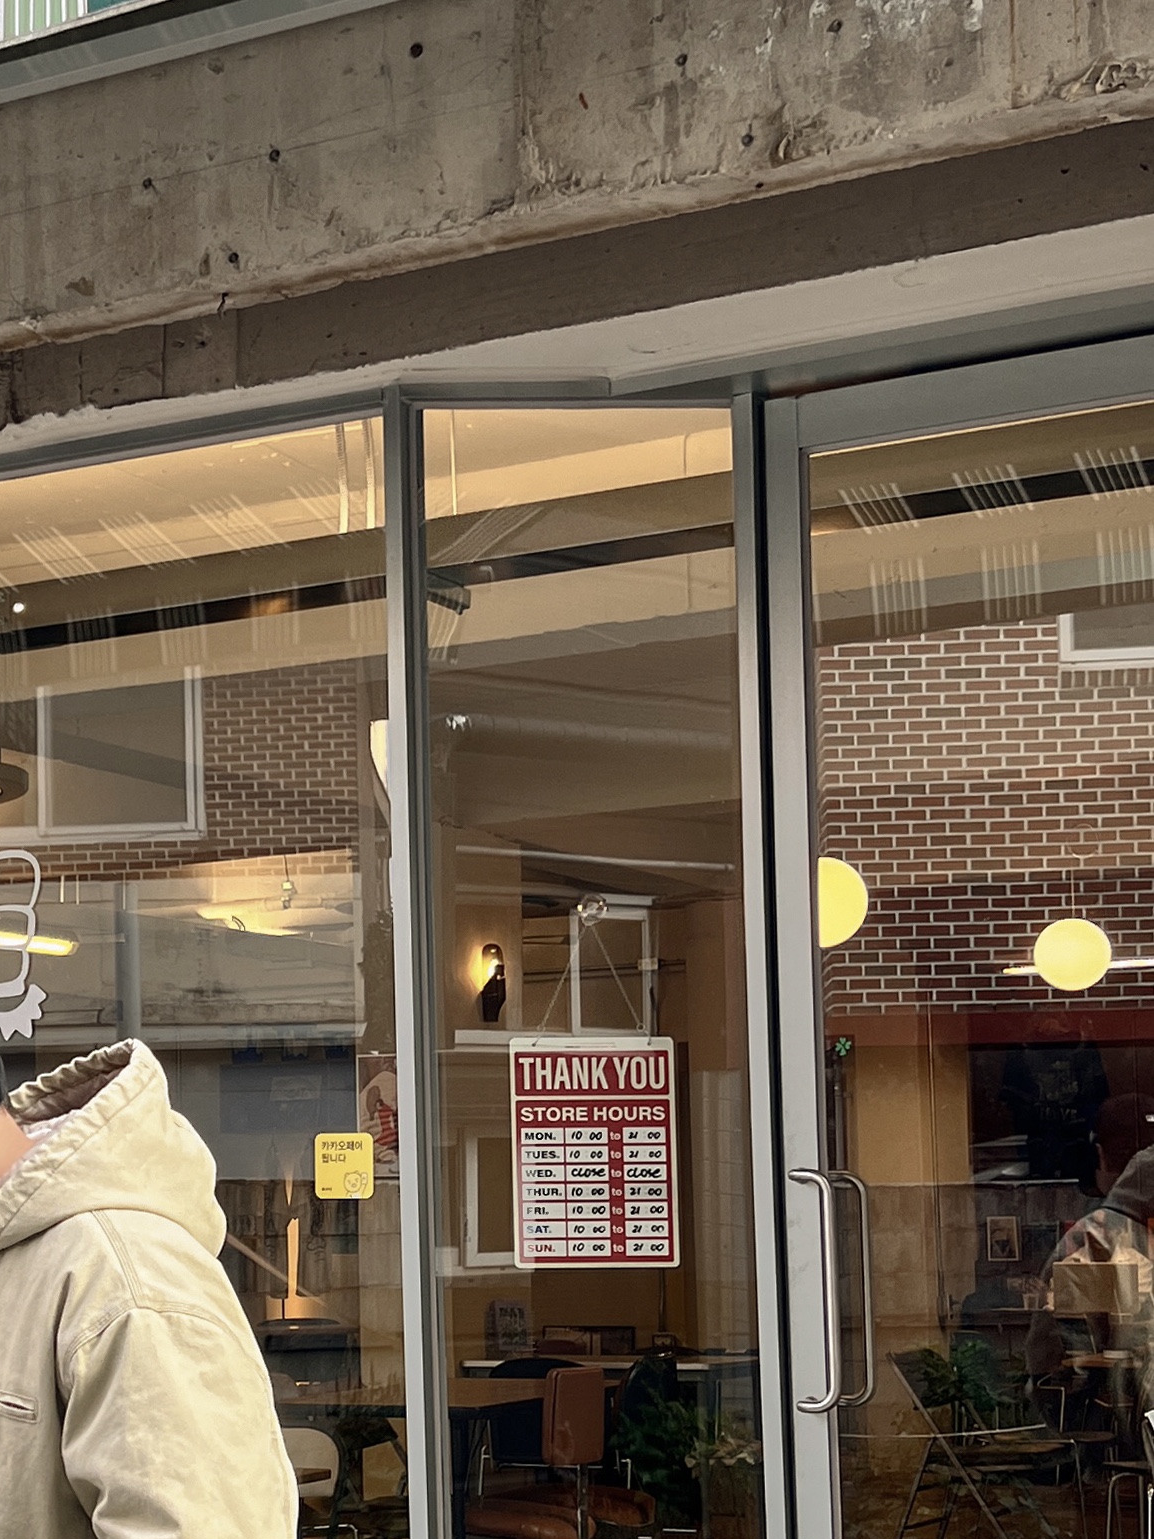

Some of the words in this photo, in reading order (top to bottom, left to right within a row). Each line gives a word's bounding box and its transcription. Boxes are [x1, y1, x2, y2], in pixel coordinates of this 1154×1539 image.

[519, 1057, 609, 1090] THANK
[612, 1056, 665, 1090] YOU
[520, 1106, 588, 1122] STORE
[593, 1106, 666, 1122] HOURS
[524, 1132, 557, 1141] MON.
[610, 1131, 621, 1141] to
[321, 1140, 363, 1151] 카카오페이
[321, 1153, 346, 1164] 됩니다
[525, 1150, 560, 1159] TUES.
[610, 1150, 622, 1159] to
[525, 1169, 557, 1178] WED.
[611, 1168, 622, 1178] to
[526, 1188, 563, 1197] THUR.
[611, 1187, 623, 1197] to
[526, 1206, 550, 1215] FRI.
[611, 1206, 623, 1216] to
[526, 1225, 552, 1234] SAT.
[611, 1225, 624, 1234] to
[527, 1244, 556, 1253] SUN.
[612, 1243, 624, 1253] to
